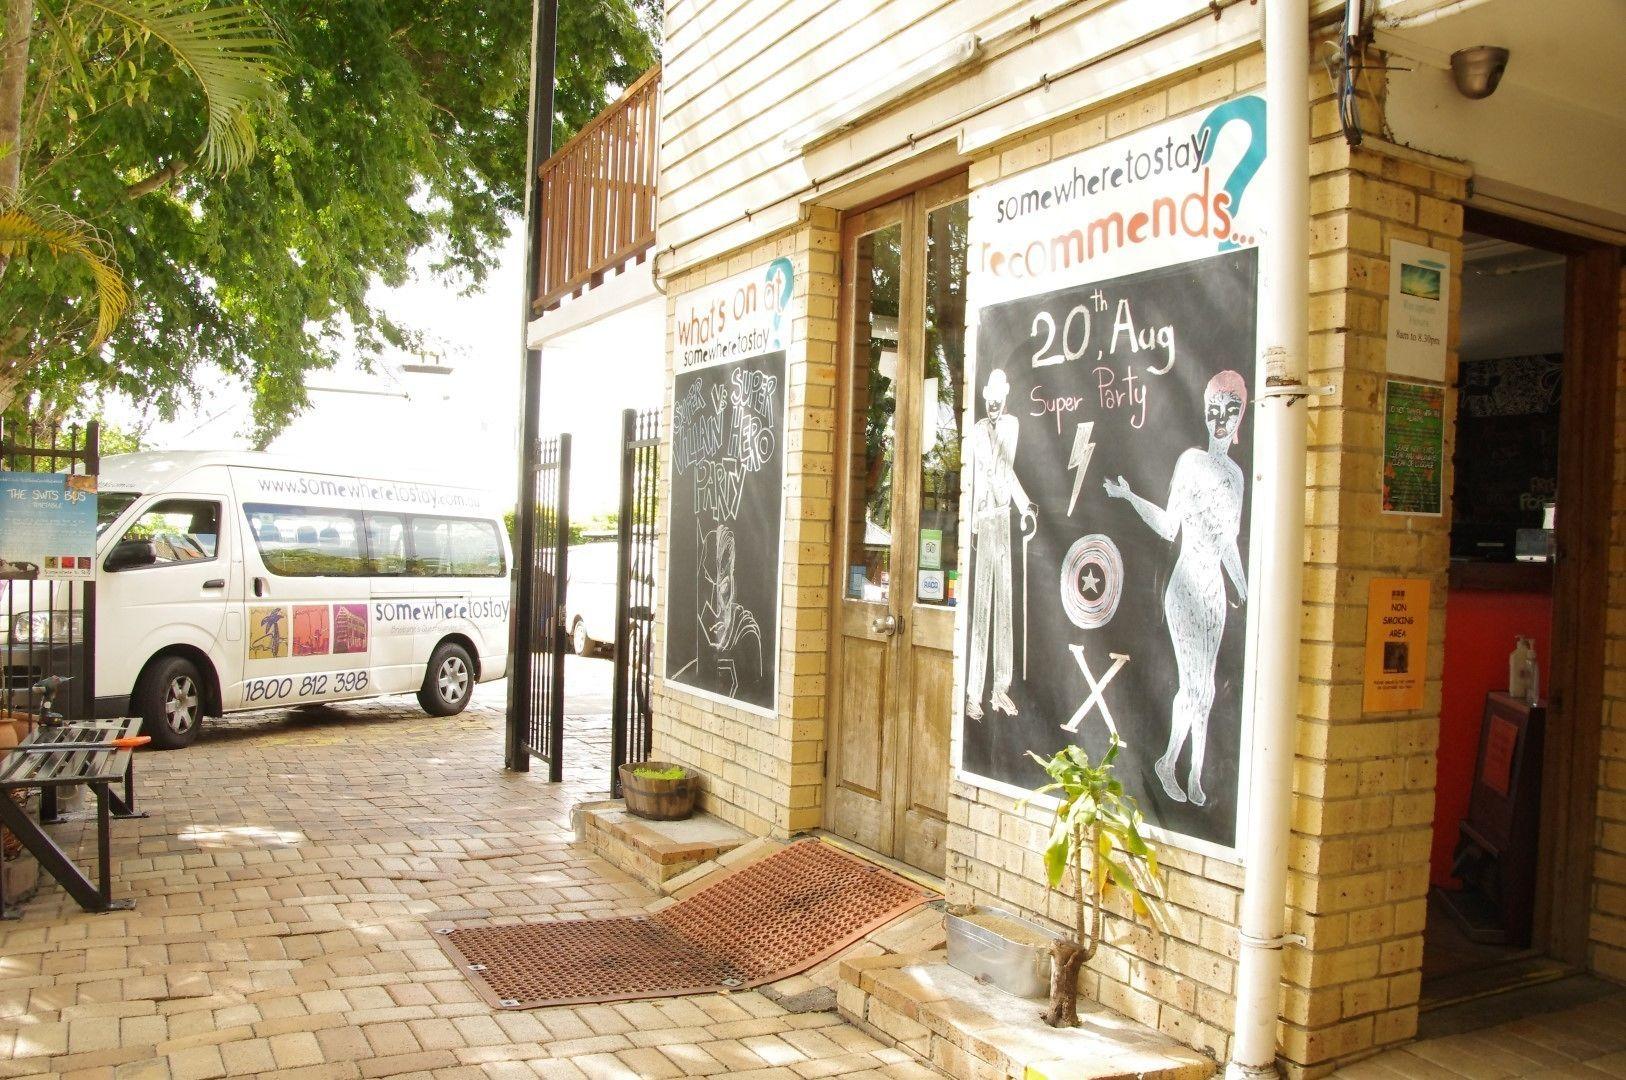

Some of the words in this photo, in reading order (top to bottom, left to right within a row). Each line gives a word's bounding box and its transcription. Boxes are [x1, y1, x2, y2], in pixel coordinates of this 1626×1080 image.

[997, 129, 1210, 224] somewheretostay
[678, 298, 726, 346] what's
[733, 281, 757, 321] on
[684, 327, 769, 367] somewheretostay
[1110, 299, 1176, 375] Aug
[1410, 331, 1417, 341] to
[673, 377, 706, 435] SUPER
[730, 367, 777, 429] SUPER
[1030, 386, 1083, 434] Super
[1092, 366, 1147, 429] Party
[673, 411, 723, 475] VILLAIN
[728, 405, 775, 472] HERO
[6, 488, 28, 500] THE
[64, 489, 86, 502] BUS
[694, 457, 746, 521] PARTY
[376, 599, 509, 622] somewheretostay
[1382, 616, 1414, 625] SMOKING
[1391, 603, 1407, 612] NON
[1389, 629, 1406, 638] AREA
[245, 678, 293, 702] 1800
[299, 675, 328, 696] 812
[334, 671, 369, 694] 398
